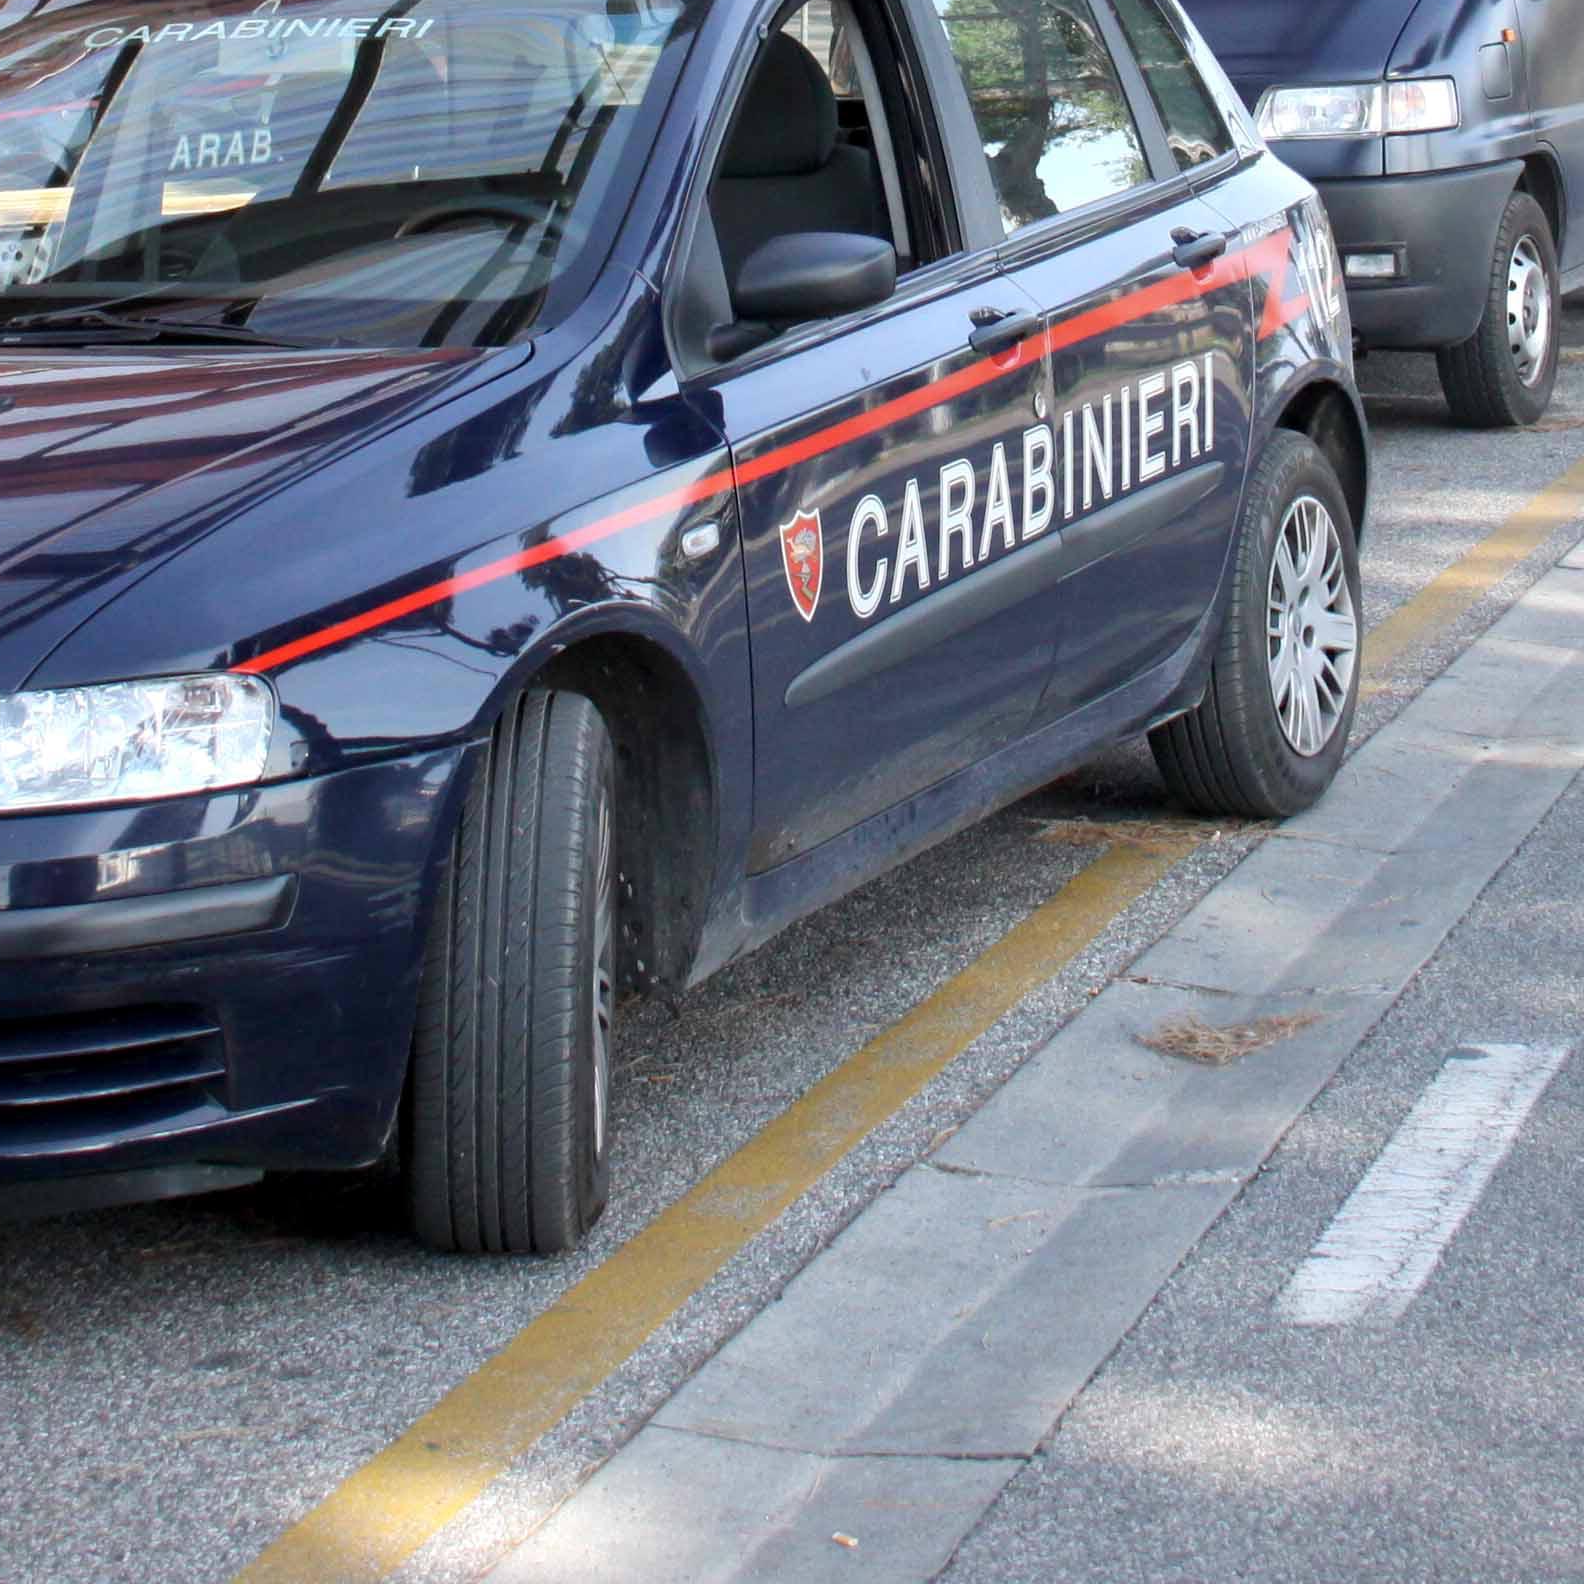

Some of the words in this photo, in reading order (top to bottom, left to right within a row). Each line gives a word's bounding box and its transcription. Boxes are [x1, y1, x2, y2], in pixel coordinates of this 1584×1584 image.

[84, 16, 434, 49] CARABINIERI
[1297, 228, 1342, 328] 112
[846, 351, 1215, 619] CARABINIERI
